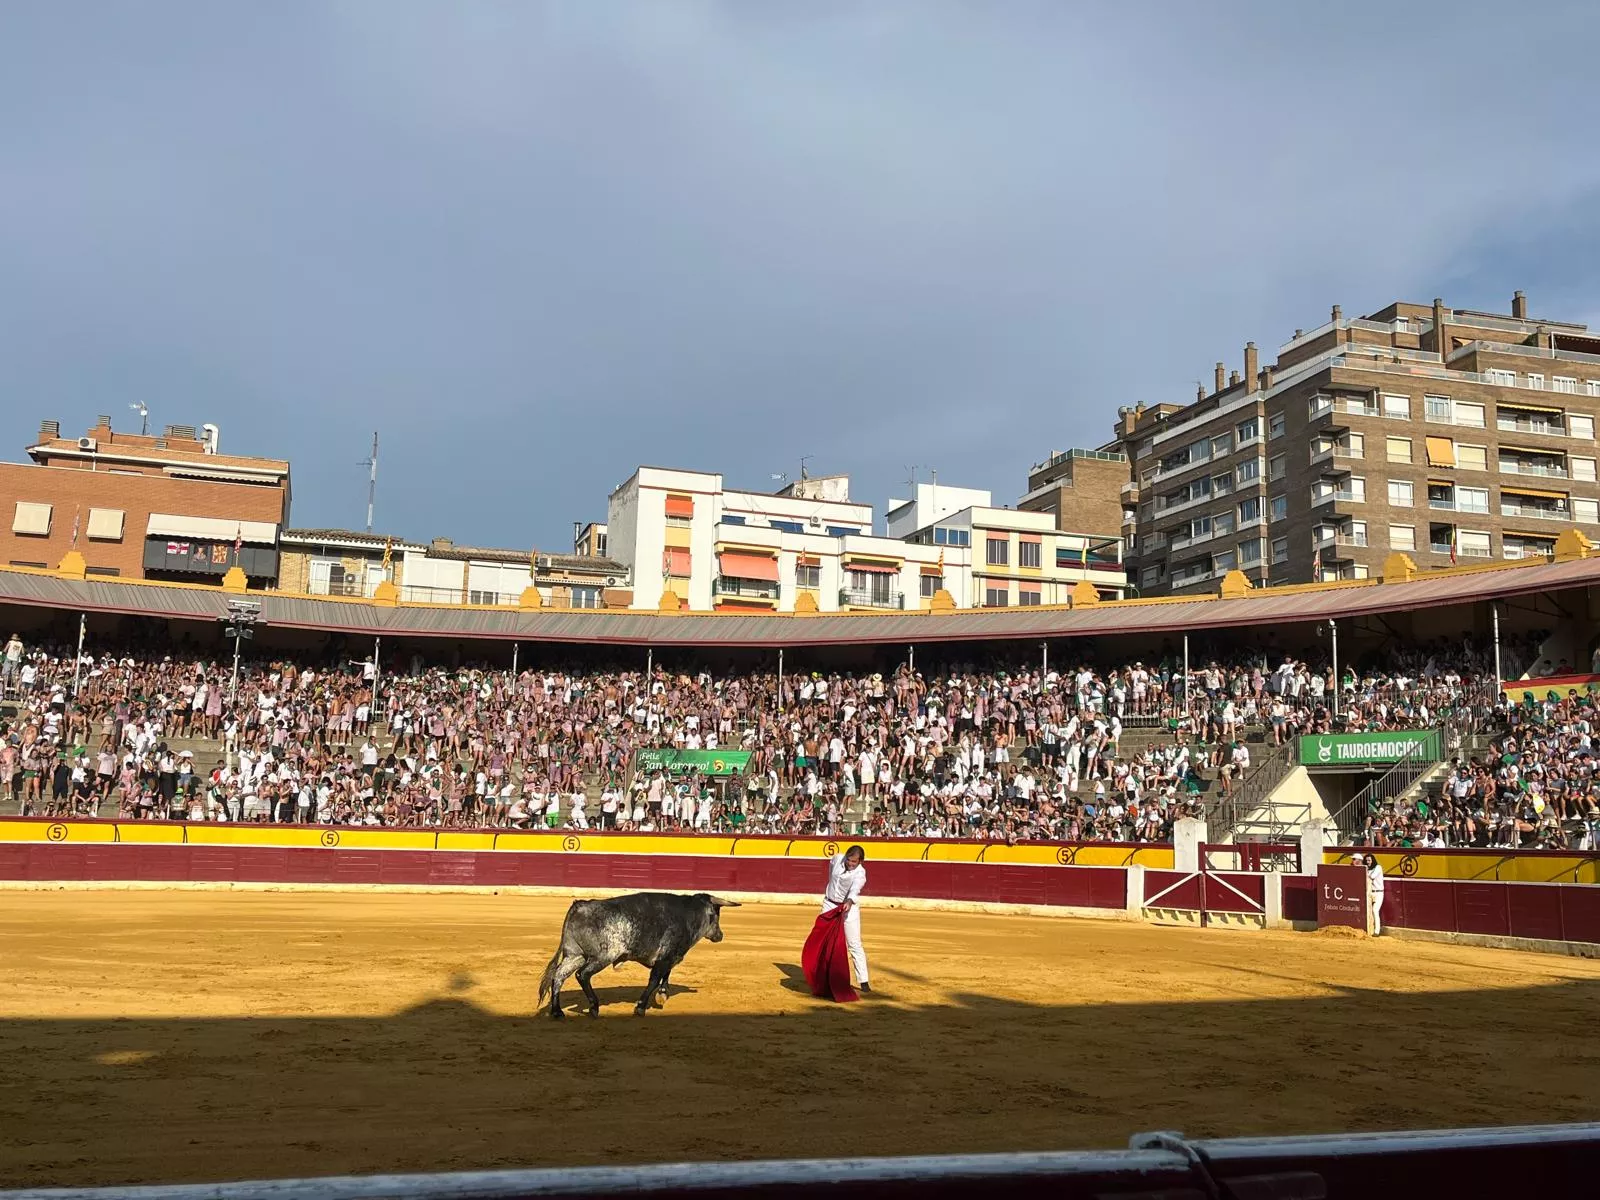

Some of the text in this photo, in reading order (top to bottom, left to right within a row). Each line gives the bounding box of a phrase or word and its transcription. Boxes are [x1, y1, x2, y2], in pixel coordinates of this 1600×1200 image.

[1336, 738, 1423, 759] TAUROEMOCIÓN
[53, 827, 62, 839] 5
[326, 833, 334, 845] 5
[568, 838, 575, 850] 5
[828, 844, 835, 856] 5
[1061, 850, 1069, 862] 5
[1404, 858, 1413, 873] 6
